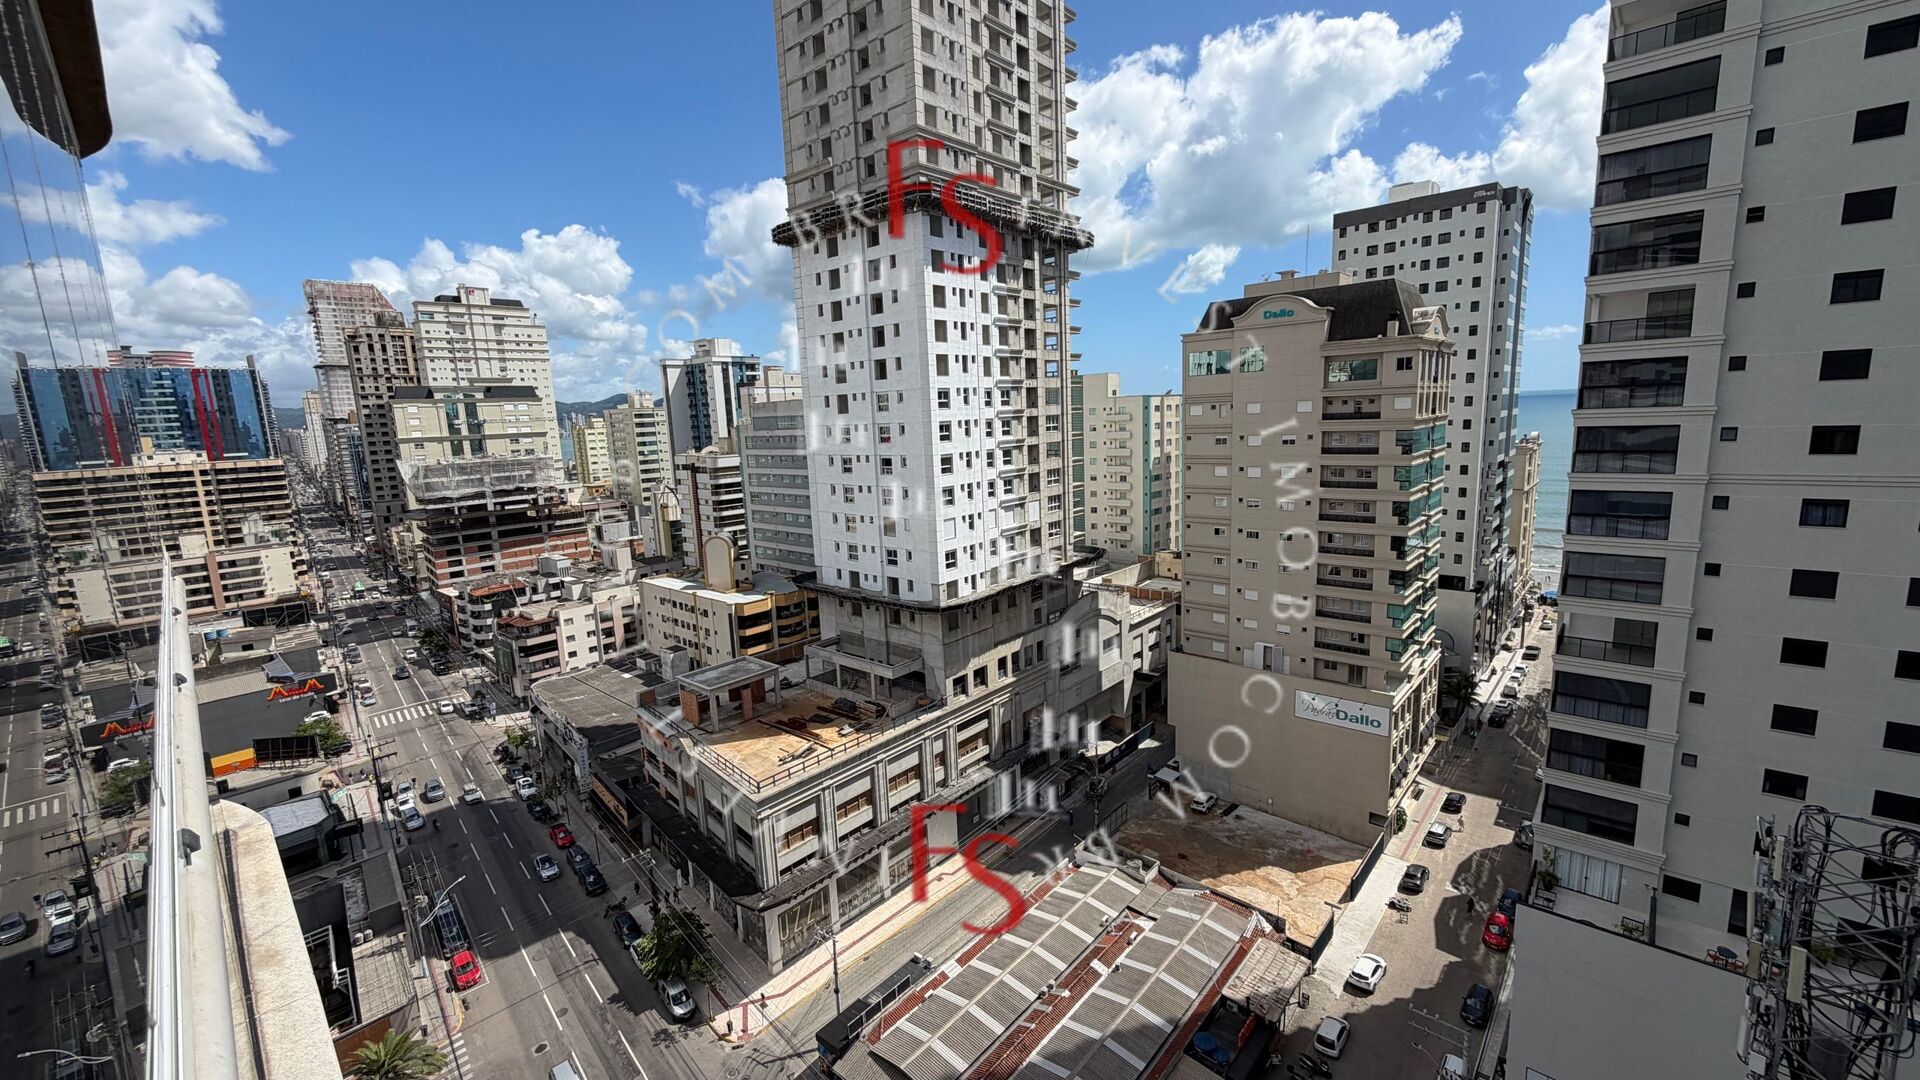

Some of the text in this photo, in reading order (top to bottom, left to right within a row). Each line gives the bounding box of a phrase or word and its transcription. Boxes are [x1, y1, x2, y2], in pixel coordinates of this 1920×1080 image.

[1263, 307, 1295, 320] Dallo
[1335, 709, 1382, 728] Dallo
[779, 890, 825, 941] UZZI
